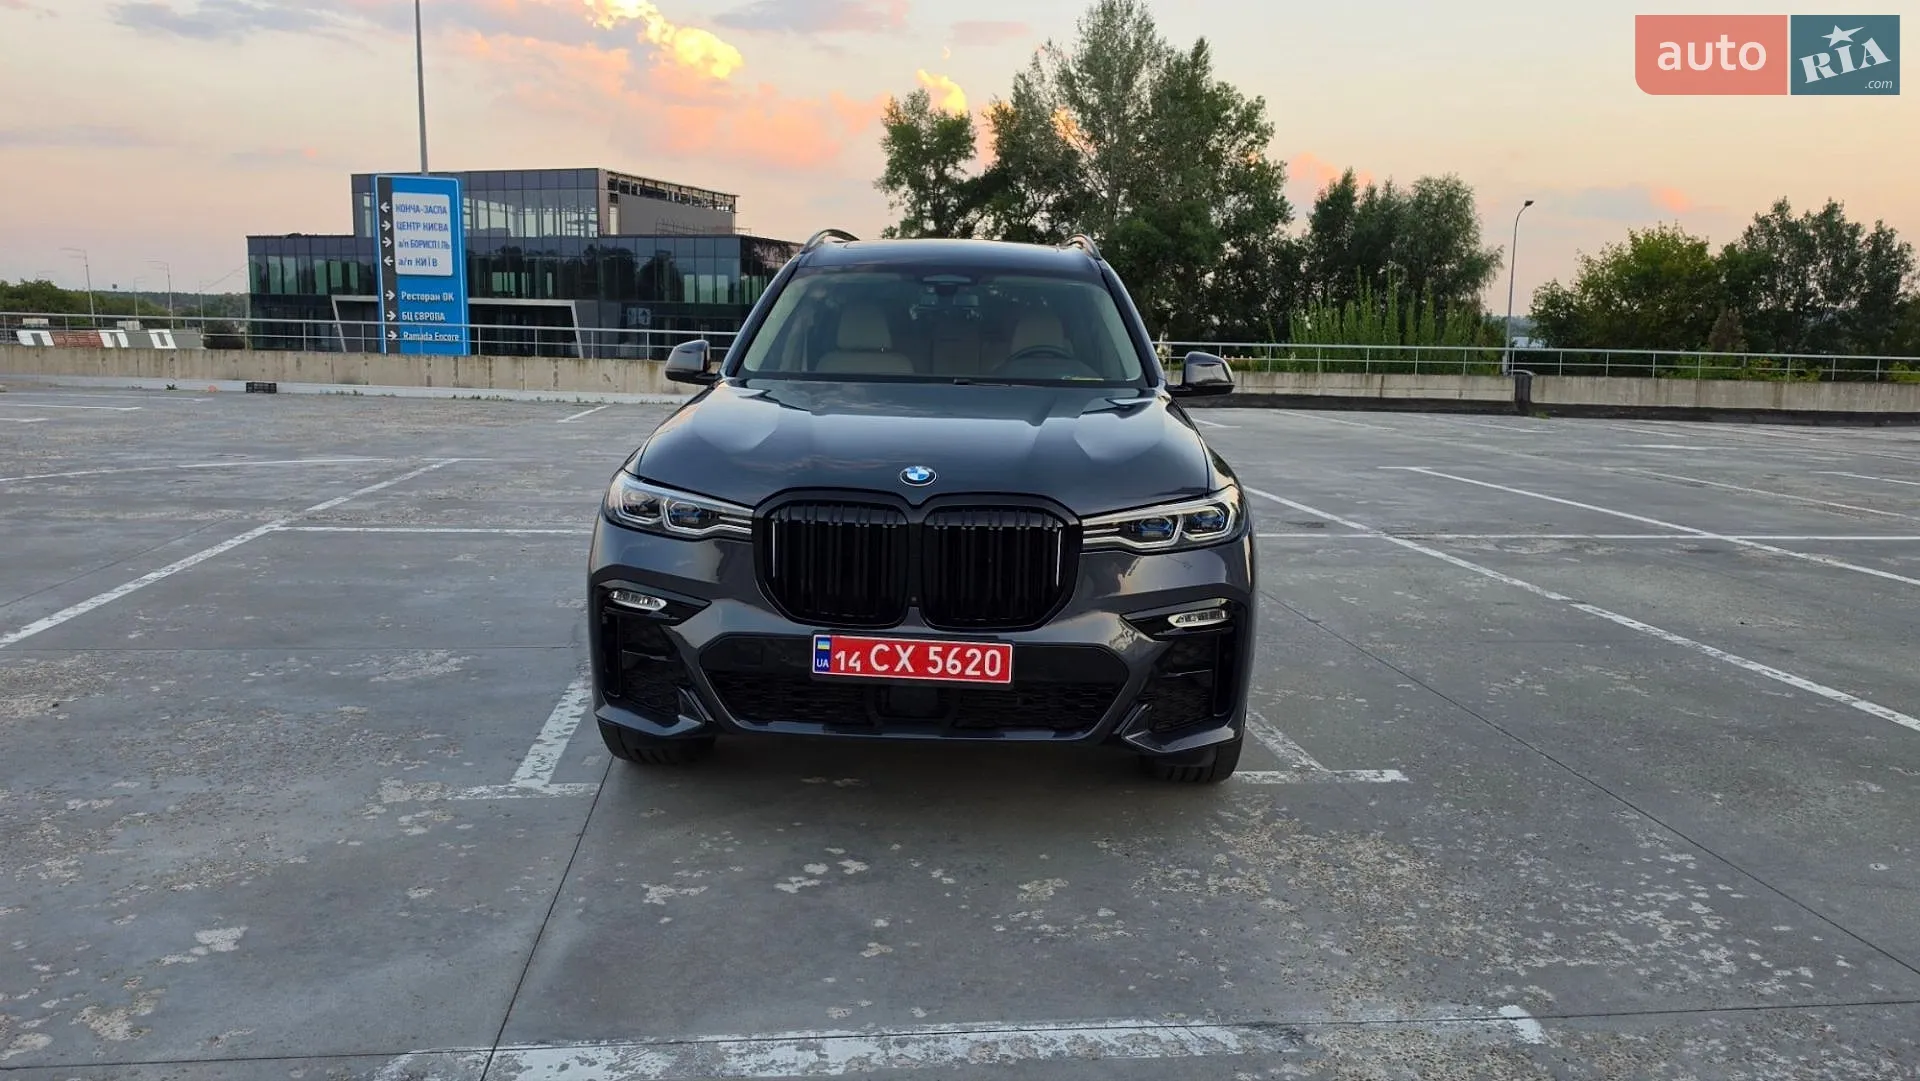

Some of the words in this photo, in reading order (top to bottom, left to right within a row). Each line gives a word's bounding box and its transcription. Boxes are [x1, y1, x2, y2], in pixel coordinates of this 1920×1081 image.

[396, 221, 421, 231] ЦЕНТР
[398, 257, 412, 266] а/п
[401, 291, 441, 302] Ресторан
[401, 311, 414, 321] БЦ
[403, 331, 433, 341] Ramada
[434, 332, 459, 342] Encore
[816, 659, 830, 668] UA
[834, 650, 861, 672] 14
[869, 644, 916, 673] CX
[927, 646, 1001, 677] 5620
